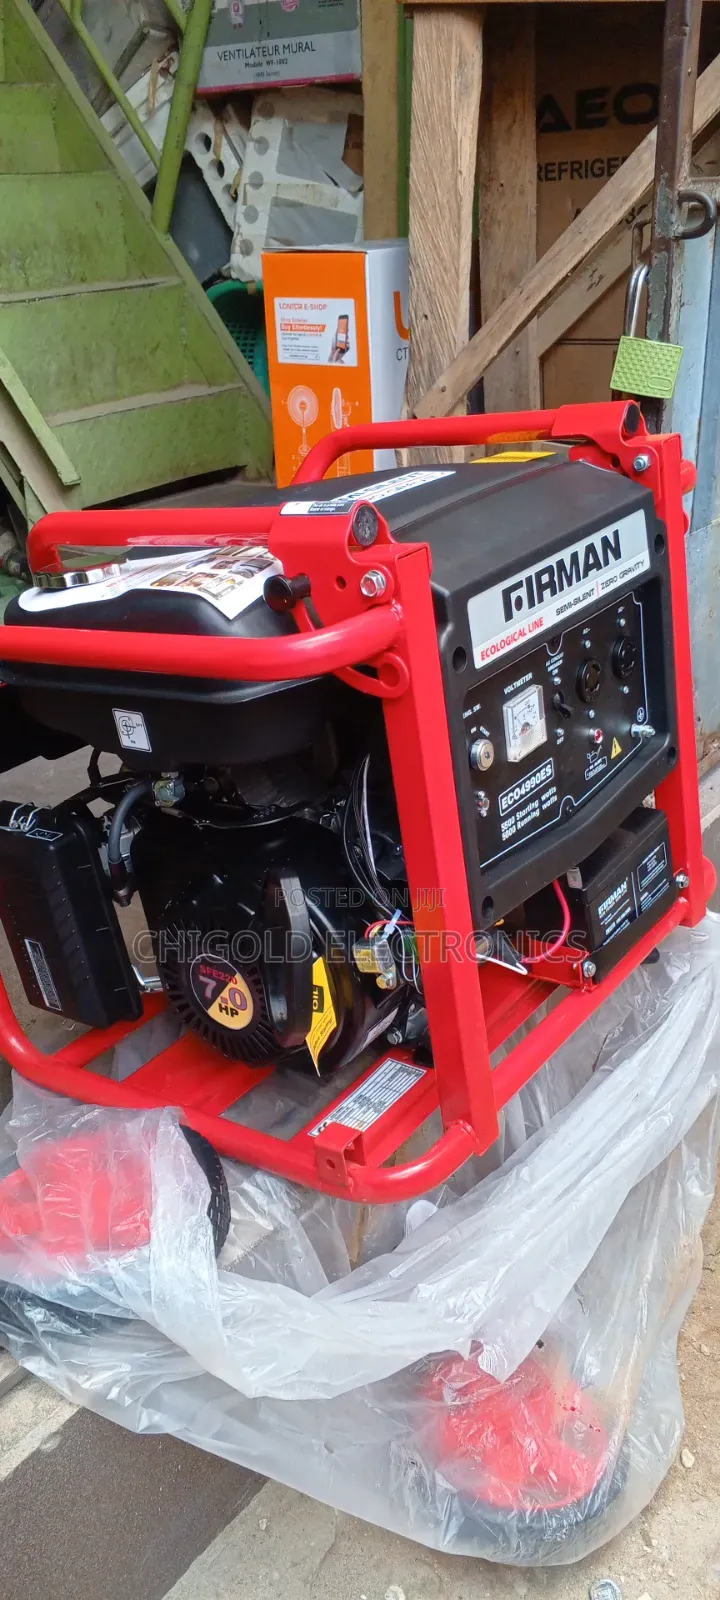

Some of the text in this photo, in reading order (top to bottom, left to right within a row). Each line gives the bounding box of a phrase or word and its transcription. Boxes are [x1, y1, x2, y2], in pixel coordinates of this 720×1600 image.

[217, 41, 316, 61] VENTILATEUR MURAL
[537, 156, 629, 182] REFRIGE
[502, 529, 622, 623] FIRMAN
[555, 559, 645, 616] SEMI-SILENT ZERO GRAVITY
[480, 617, 544, 661] ECOLOGICAL LINE
[503, 672, 533, 695] VOLTMETER
[501, 764, 552, 809] ECO4990ES
[516, 800, 539, 820] Starting
[541, 786, 557, 801] watts
[517, 808, 540, 830] Running
[542, 795, 558, 810] watts
[200, 965, 238, 985] SFE220
[218, 1003, 239, 1017] HP
